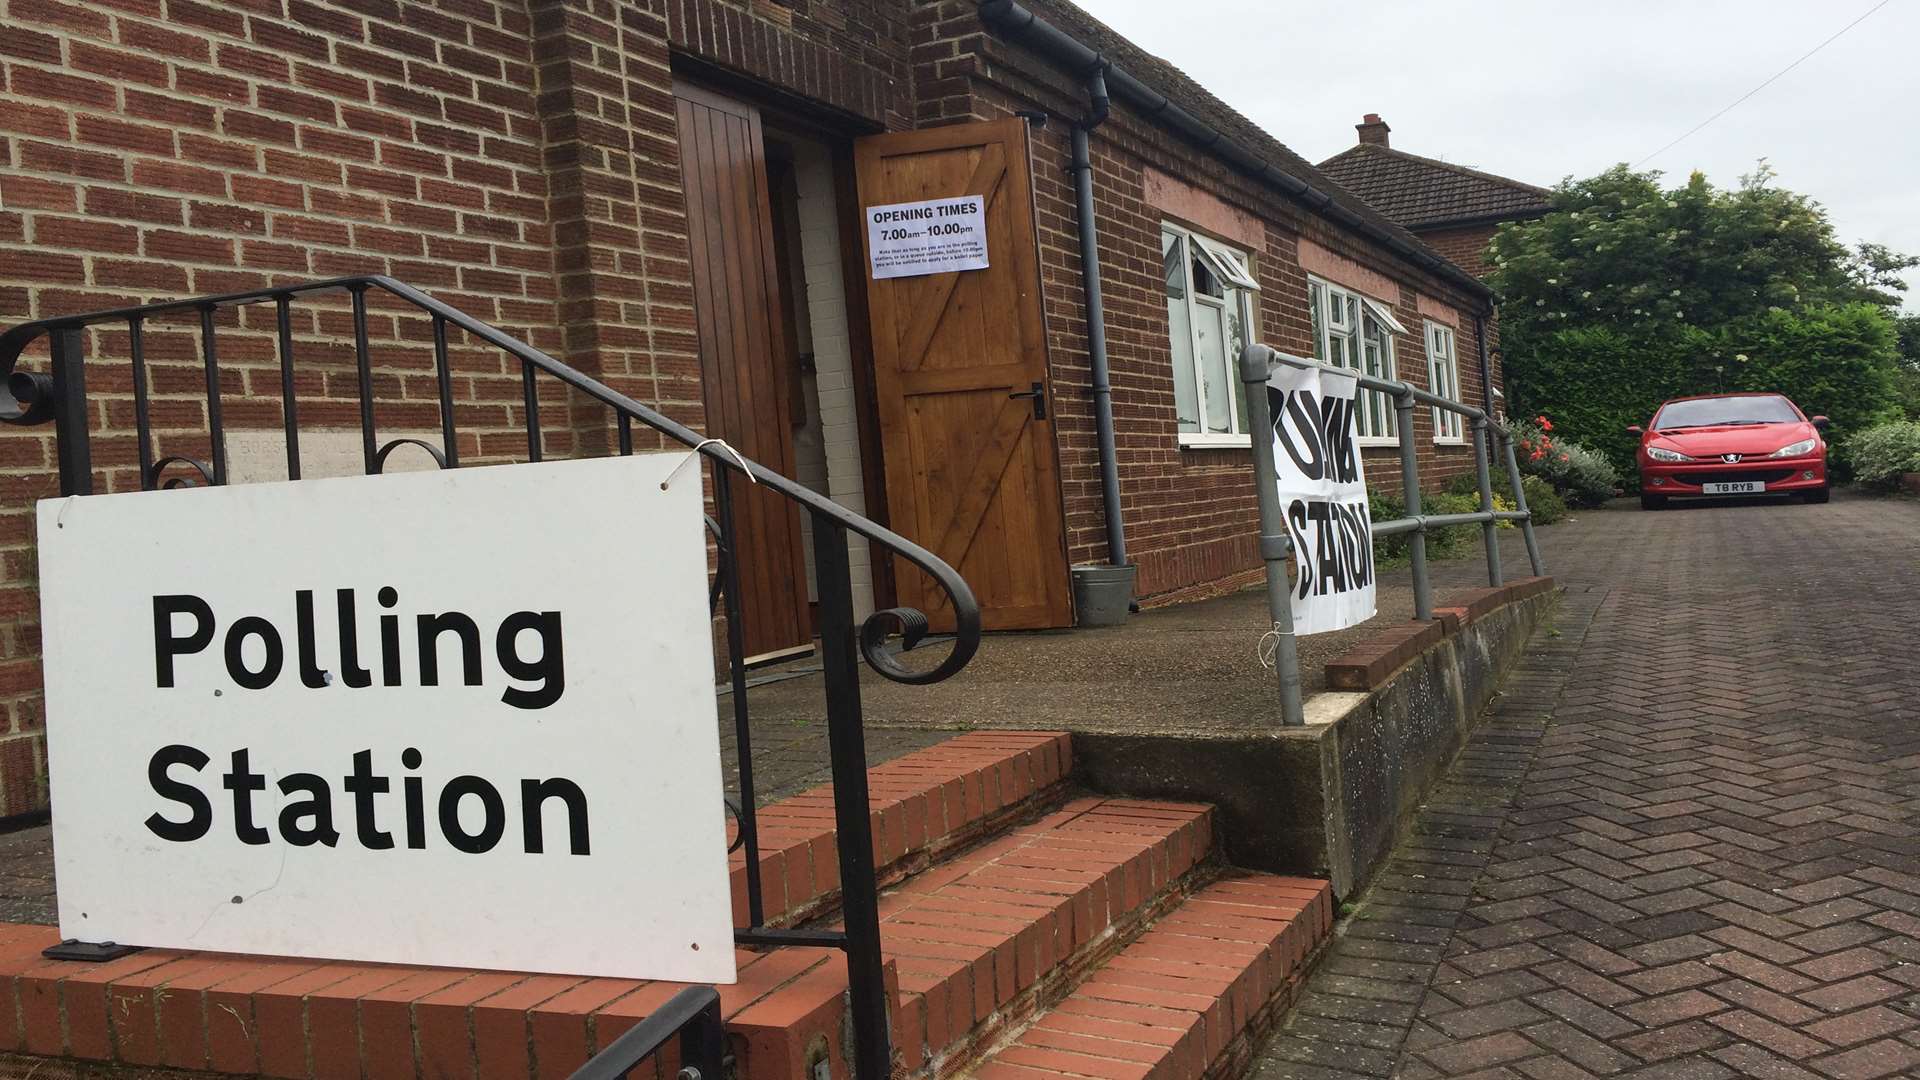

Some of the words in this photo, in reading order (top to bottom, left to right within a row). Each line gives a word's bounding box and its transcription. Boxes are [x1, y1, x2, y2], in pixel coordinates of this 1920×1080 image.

[873, 207, 933, 224] OPENING
[937, 202, 978, 217] TIMES
[1732, 482, 1754, 492] RYB
[152, 585, 566, 710] Polling
[143, 744, 591, 857] Station
